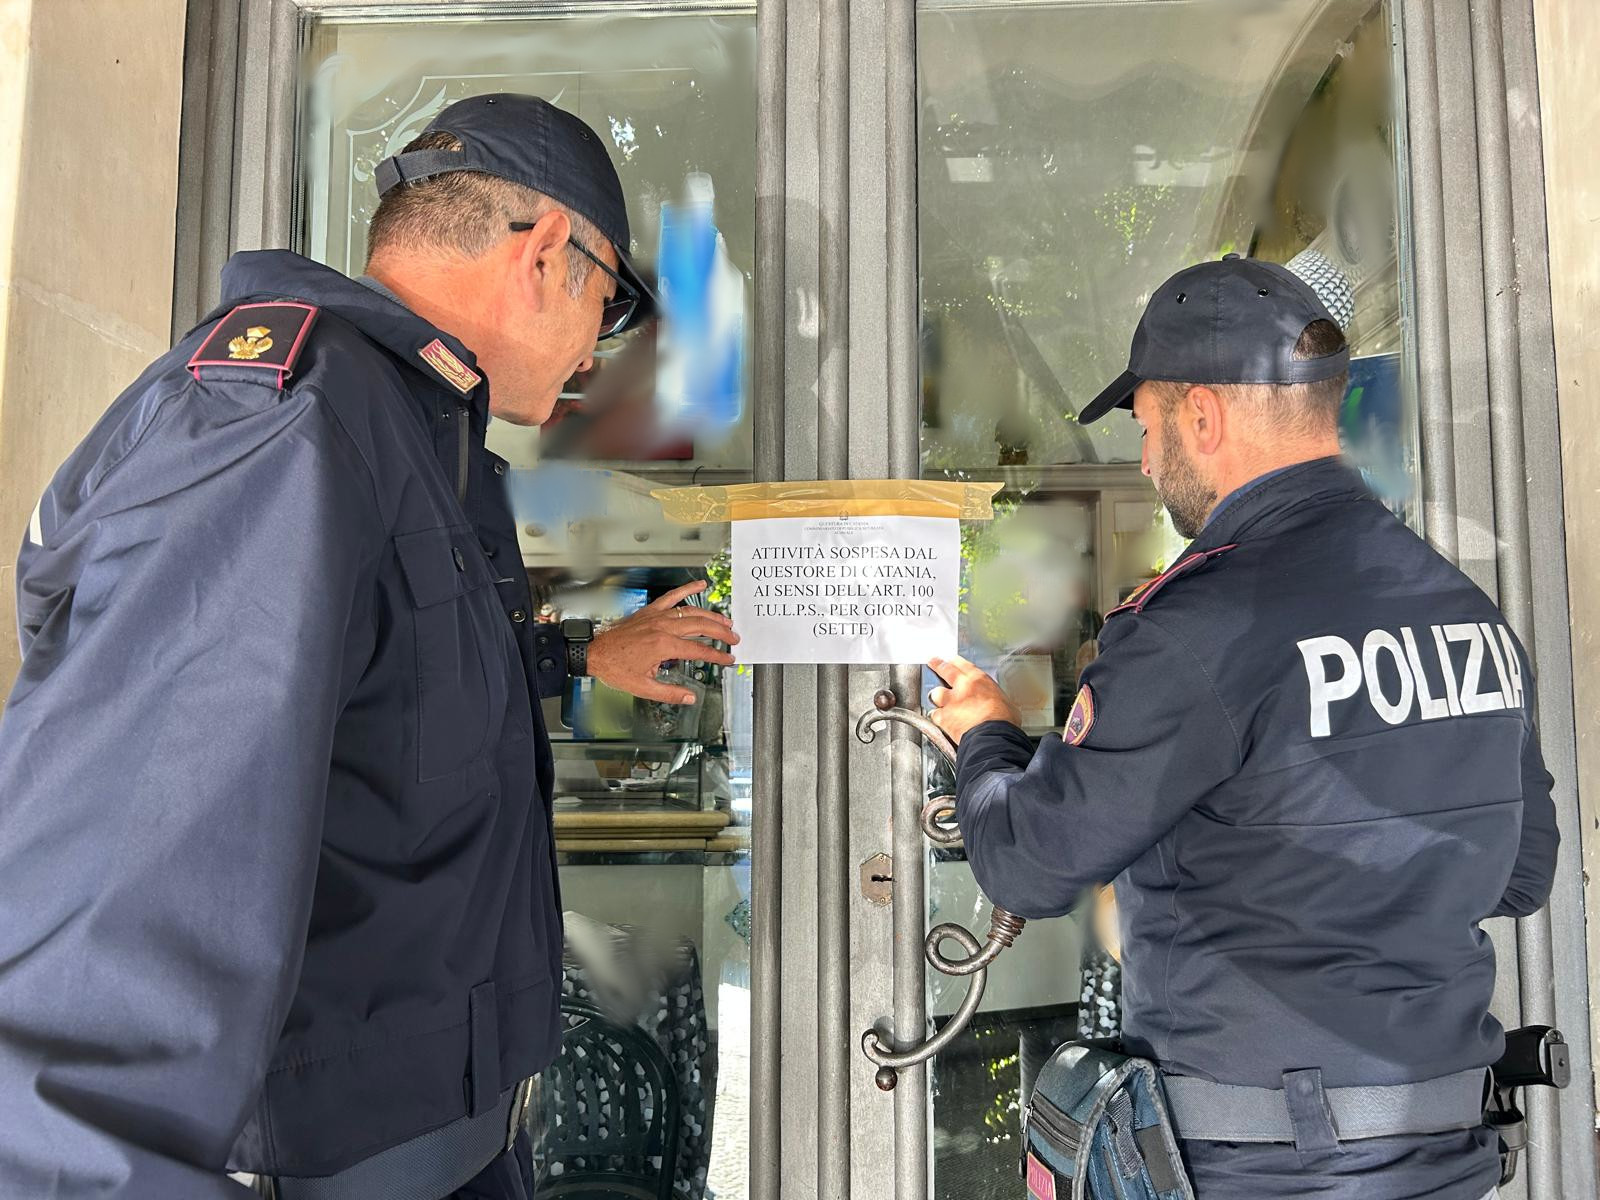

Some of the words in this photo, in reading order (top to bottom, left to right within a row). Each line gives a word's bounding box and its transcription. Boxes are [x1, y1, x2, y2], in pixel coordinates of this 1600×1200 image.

[751, 543, 825, 560] ATTIVITÀ
[830, 546, 900, 560] SOSPESA
[904, 547, 938, 560] DAL
[751, 565, 836, 581] QUESTORE
[840, 565, 857, 578] DI
[862, 565, 937, 580] CATANIA,
[754, 584, 770, 597] AI
[774, 584, 819, 597] SENSI
[824, 584, 906, 597] DELL'ART.
[912, 584, 934, 597] 100
[753, 603, 825, 618] T.U.L.P.S.,
[830, 603, 860, 617] PER
[864, 603, 921, 617] GIORNI
[926, 604, 934, 617] 7
[812, 622, 874, 639] (SETTE)
[1296, 623, 1525, 738] POLIZIA
